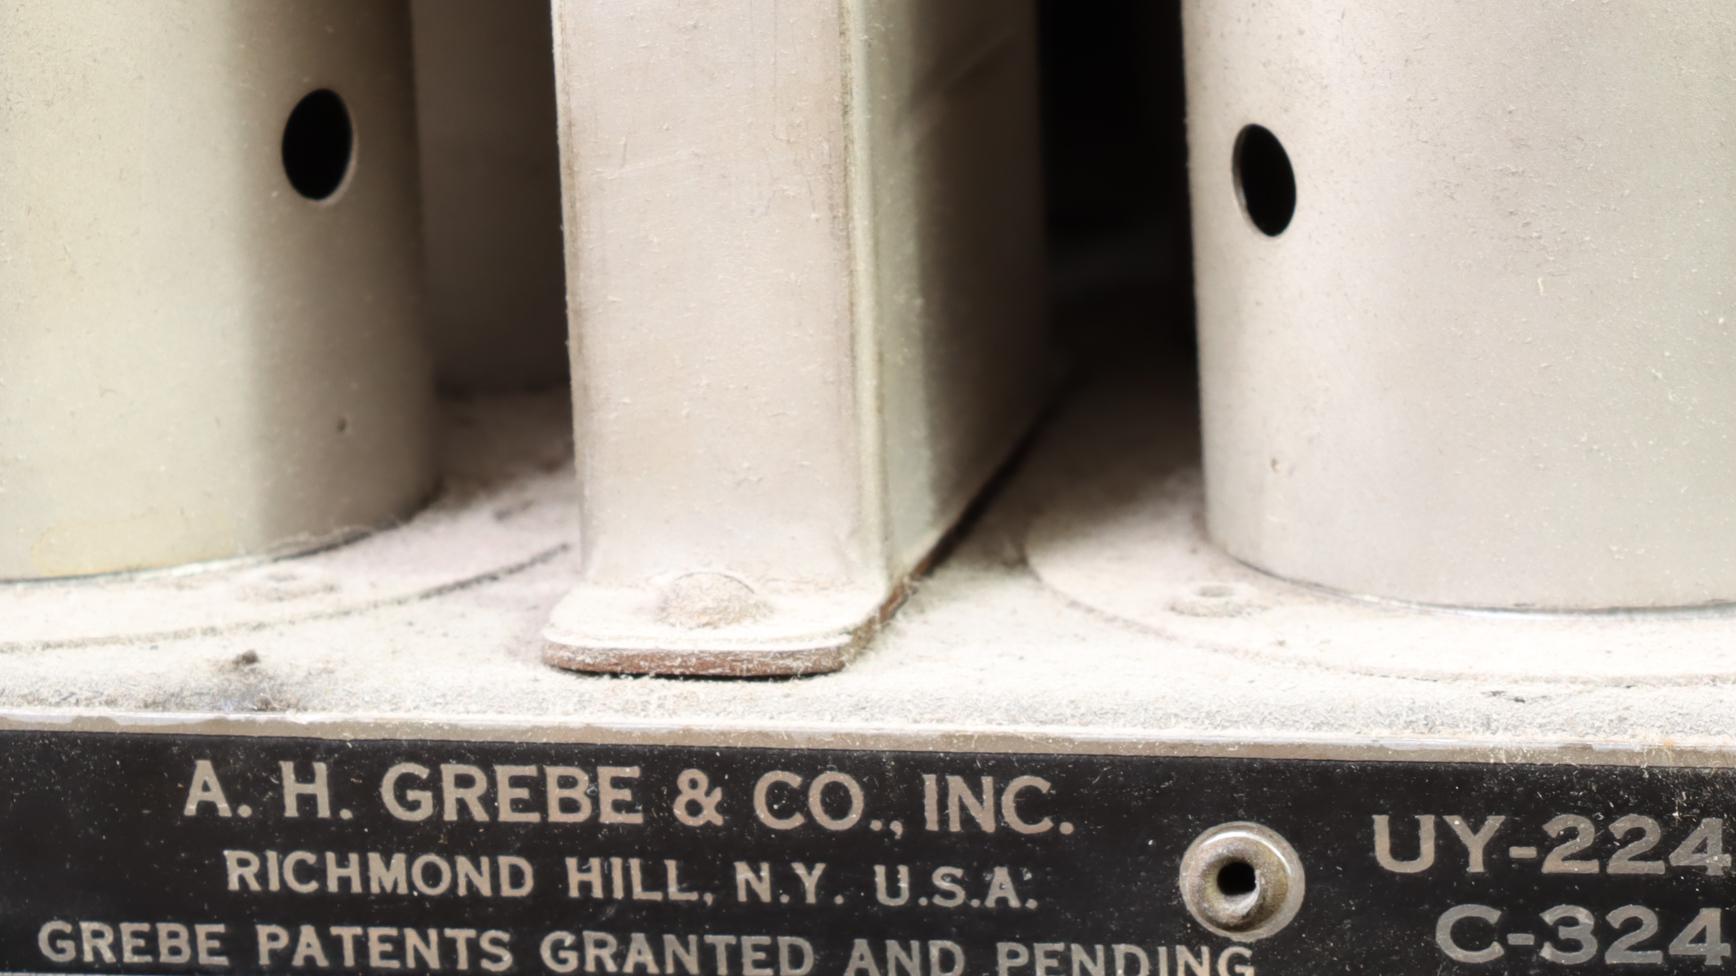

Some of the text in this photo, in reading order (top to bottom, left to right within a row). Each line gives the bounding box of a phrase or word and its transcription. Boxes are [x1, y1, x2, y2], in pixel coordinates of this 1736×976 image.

[183, 760, 1074, 838] A. H. GREBE & CO., INC.
[1372, 813, 1732, 877] UY-224
[223, 850, 1038, 909] RICHMOND HILL, N.Y. U.S.A.
[38, 920, 229, 966] GREBE
[256, 924, 512, 972] PATENTS
[540, 931, 814, 976] GRANTED
[1435, 904, 1732, 966] C-324
